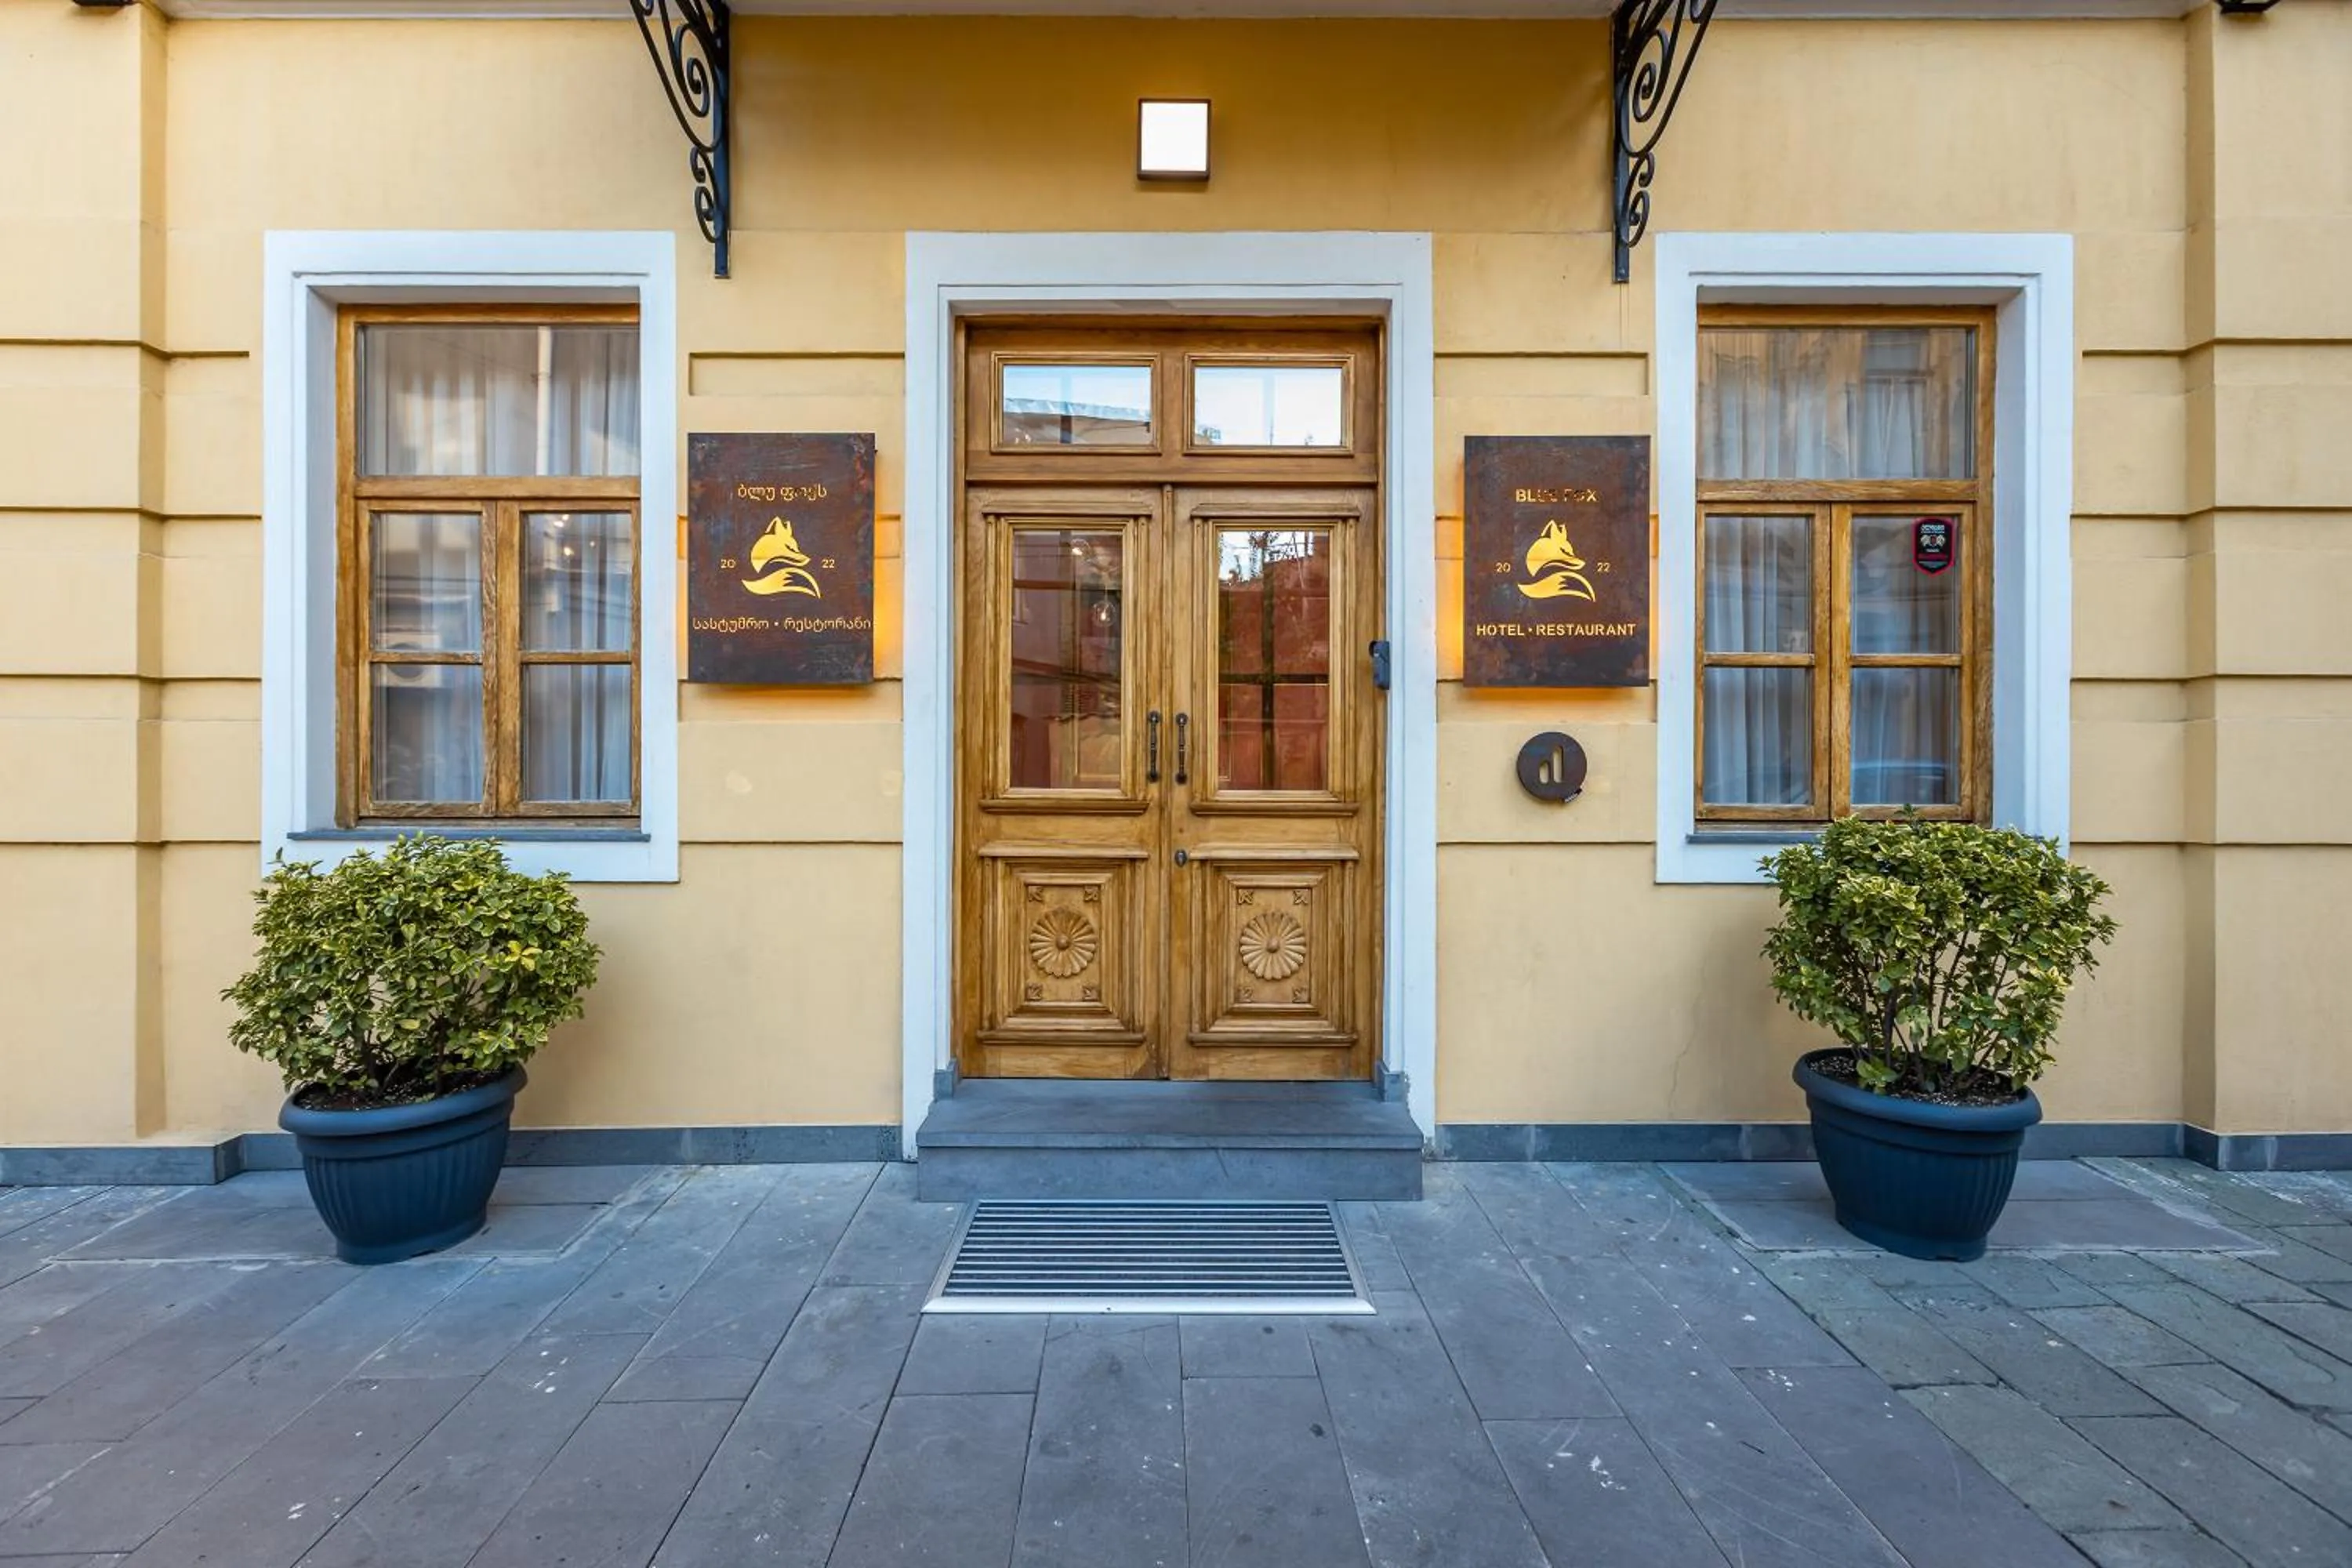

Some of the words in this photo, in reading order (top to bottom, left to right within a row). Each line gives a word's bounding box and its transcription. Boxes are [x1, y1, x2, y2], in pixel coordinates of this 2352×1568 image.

[738, 483, 775, 501] ბლუ
[720, 559, 736, 569] 20
[821, 559, 836, 569] 22
[1494, 562, 1512, 573] 20
[1596, 562, 1611, 572] 22
[691, 617, 770, 633] სასტუმრო
[783, 617, 872, 633] რესტორანი
[1476, 623, 1525, 636] HOTEL
[1535, 623, 1637, 636] RESTAURANT
